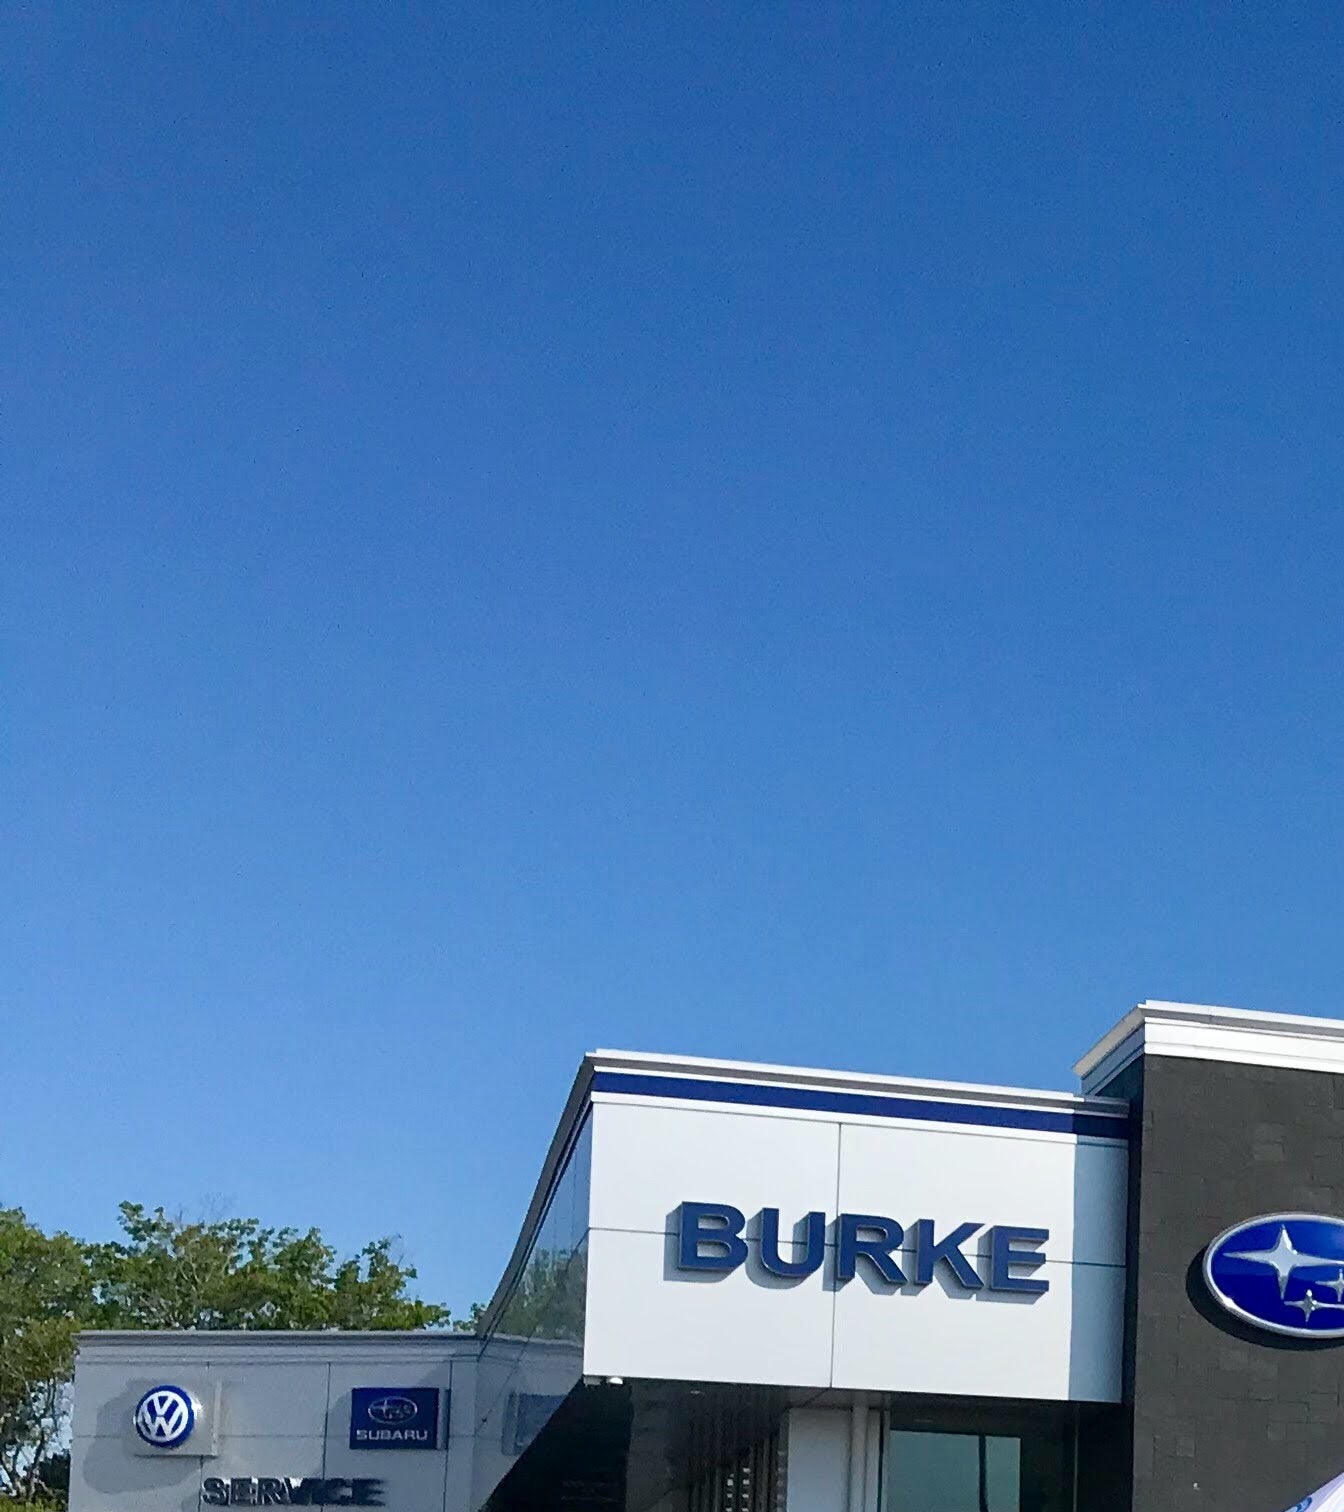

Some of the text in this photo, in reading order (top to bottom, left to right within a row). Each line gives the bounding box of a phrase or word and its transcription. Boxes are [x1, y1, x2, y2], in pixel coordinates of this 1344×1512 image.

[678, 1200, 1050, 1293] BURKE
[356, 1429, 428, 1441] SUBARU
[201, 1477, 386, 1507] SERVICE
